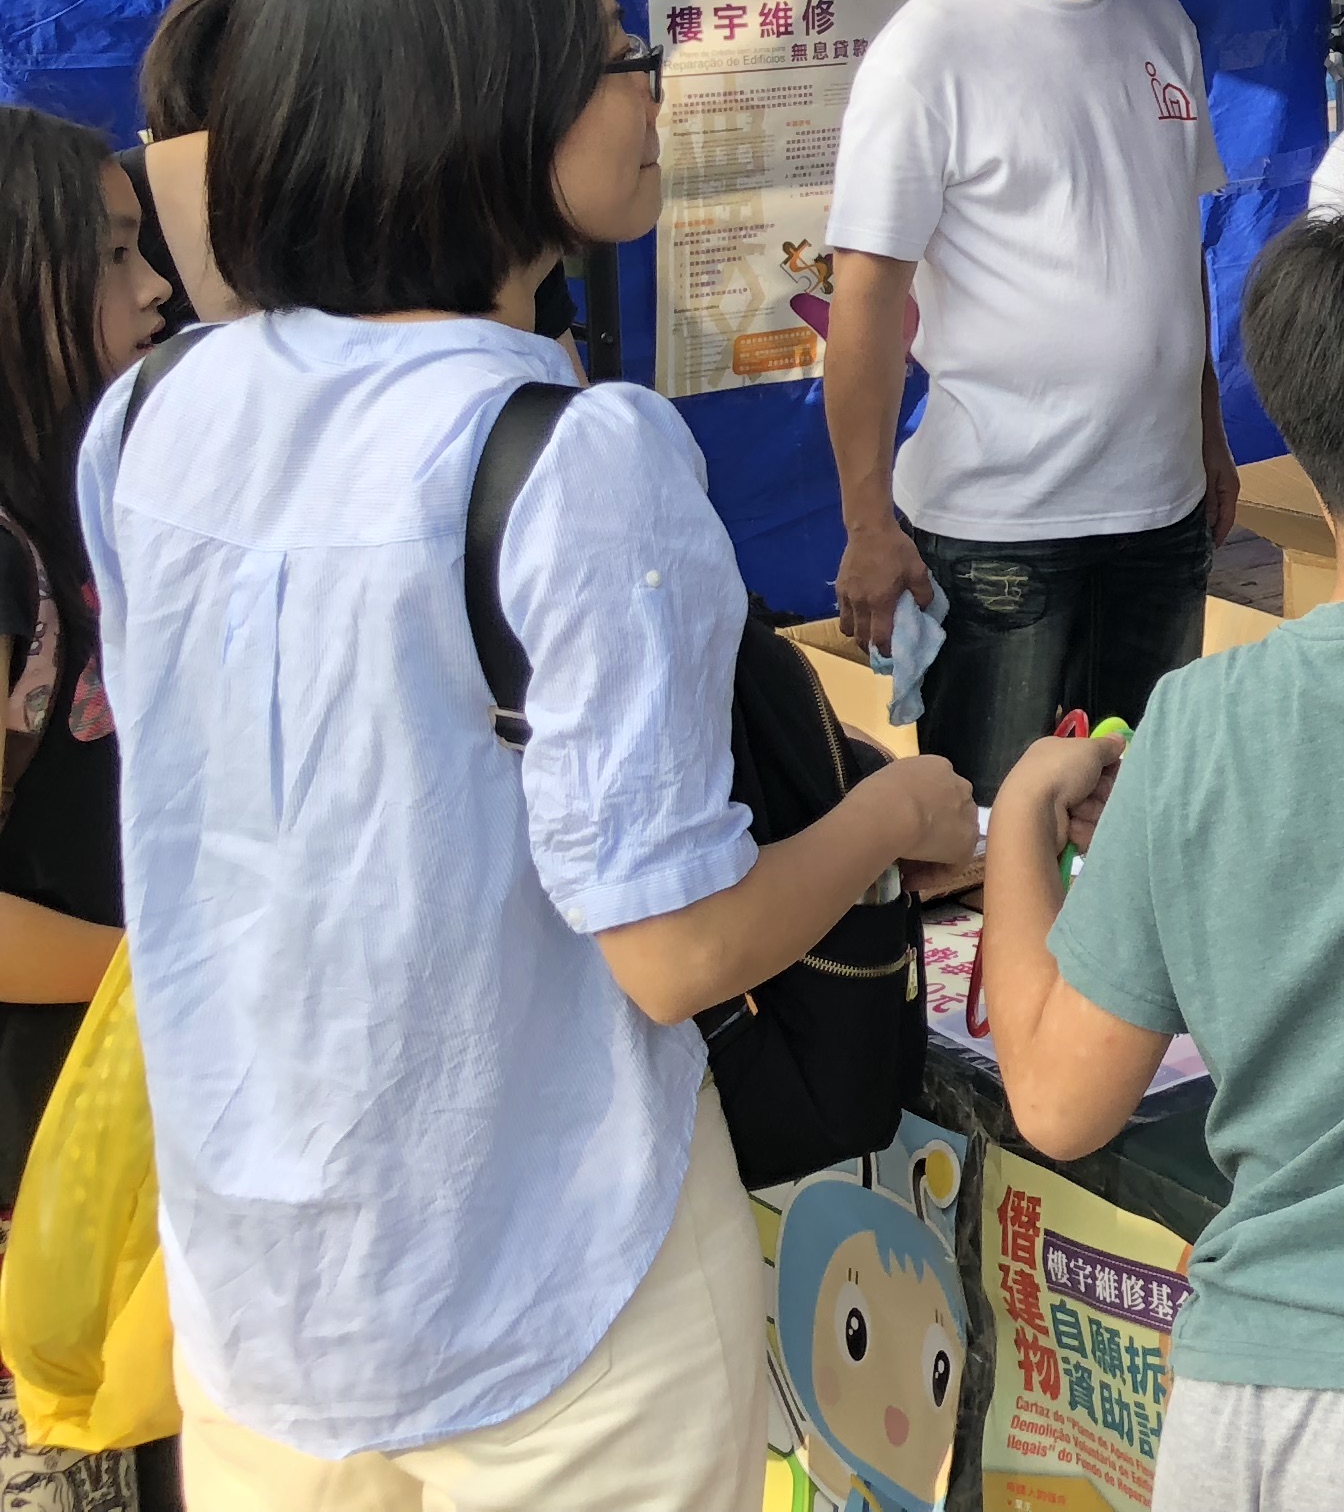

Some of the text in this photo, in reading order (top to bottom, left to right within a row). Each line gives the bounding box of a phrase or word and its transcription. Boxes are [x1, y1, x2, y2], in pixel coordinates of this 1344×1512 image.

[996, 1184, 1062, 1401] 僭建物
[1016, 1395, 1050, 1420] Cartaz
[1010, 1415, 1071, 1445] Demolição
[1058, 1448, 1073, 1464] do
[1076, 1453, 1102, 1479] Fundo
